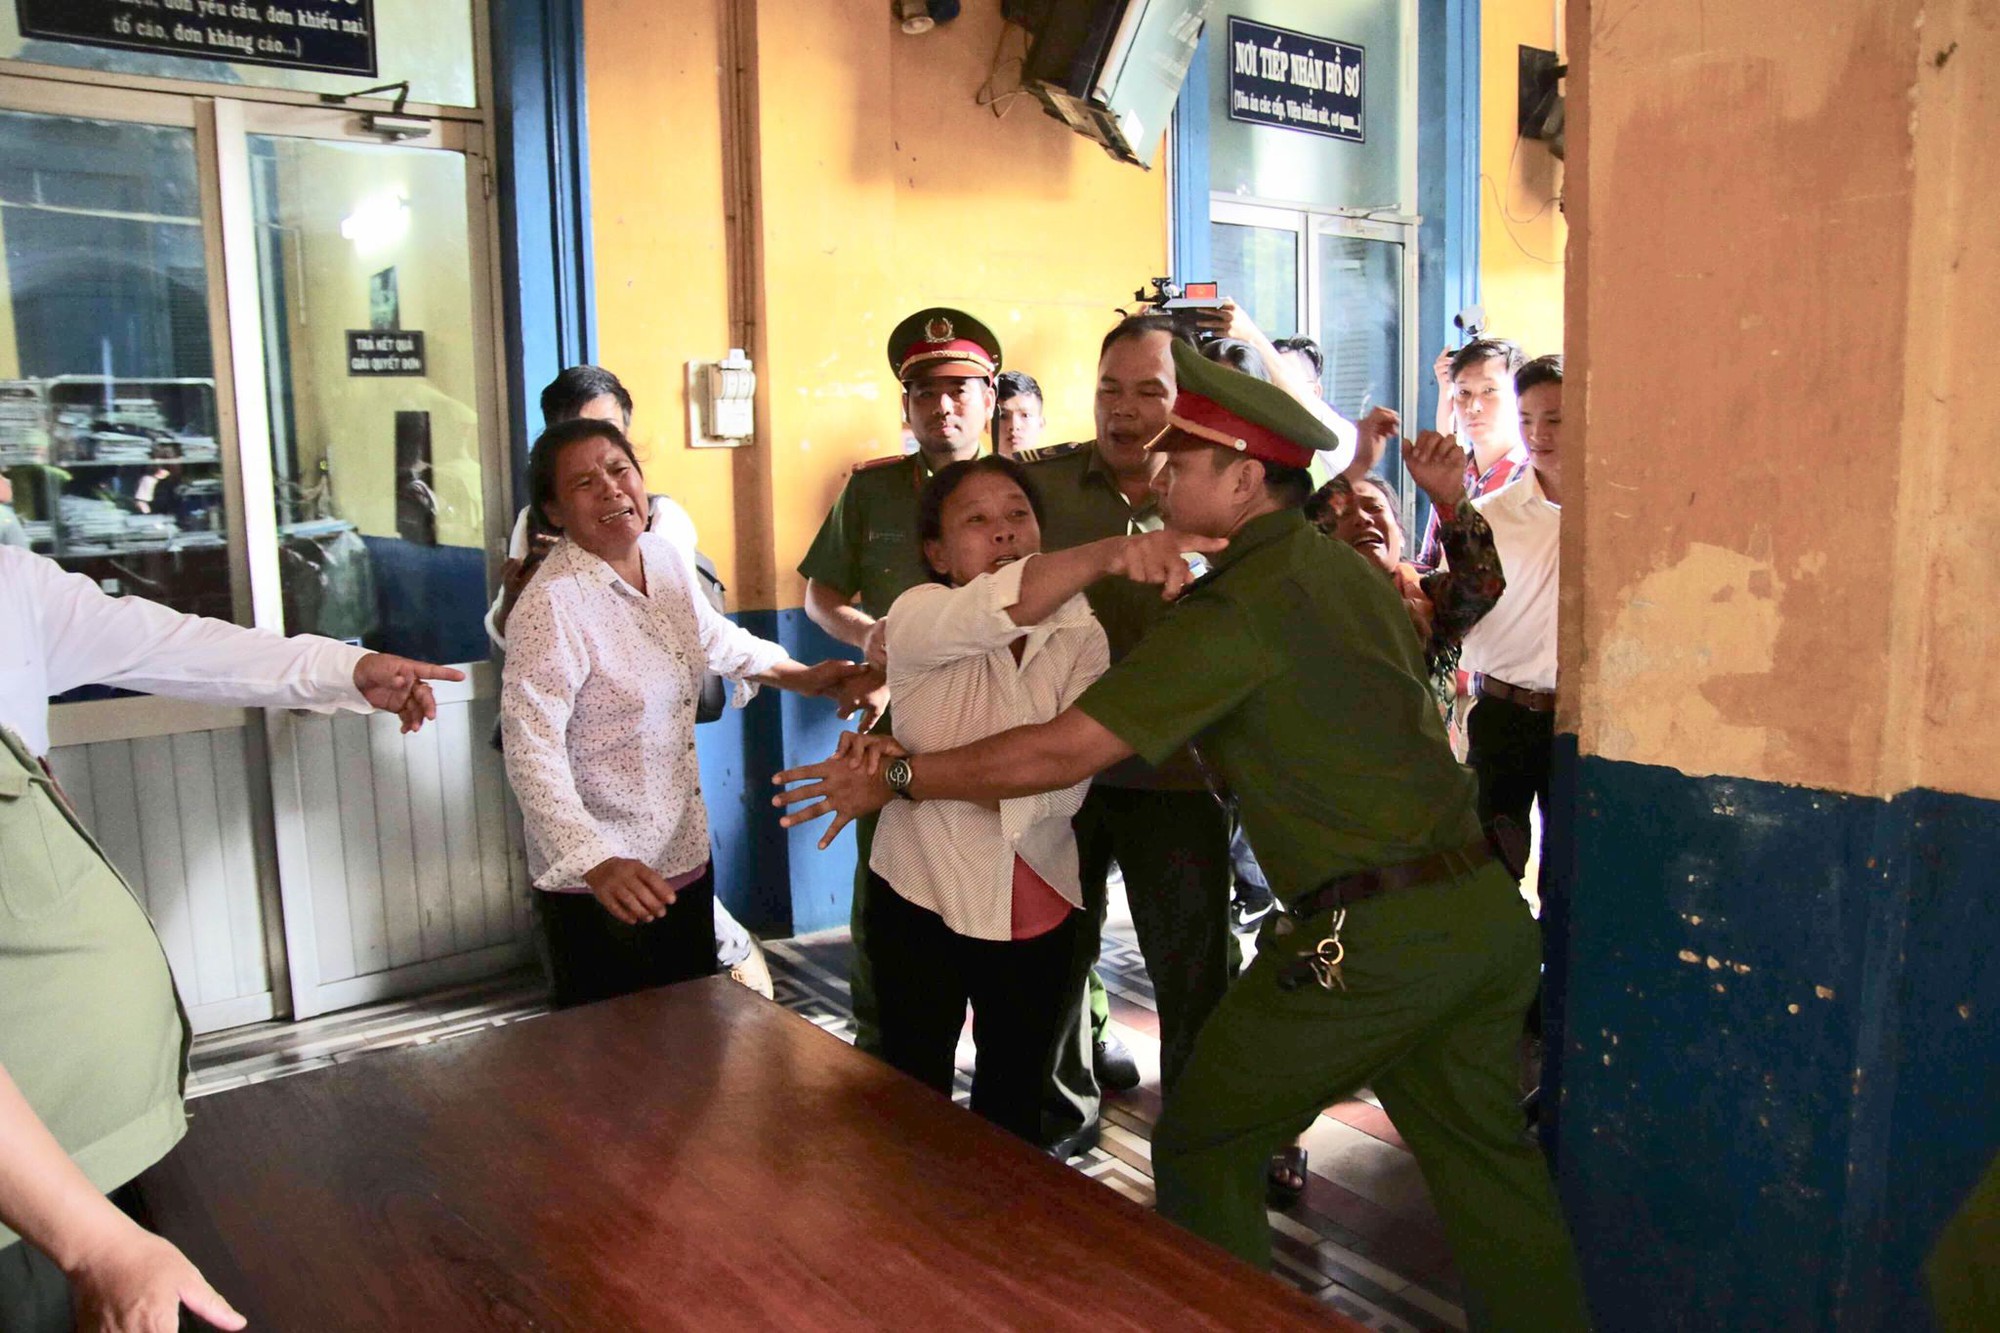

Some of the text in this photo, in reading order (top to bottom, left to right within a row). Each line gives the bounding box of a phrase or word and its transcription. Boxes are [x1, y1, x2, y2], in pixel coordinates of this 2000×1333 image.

[266, 5, 294, 25] đơn
[297, 9, 339, 31] khiếu
[173, 22, 203, 43] đơn
[1235, 35, 1360, 98] NƠI TIẾP NHẬN HỒ SƠ
